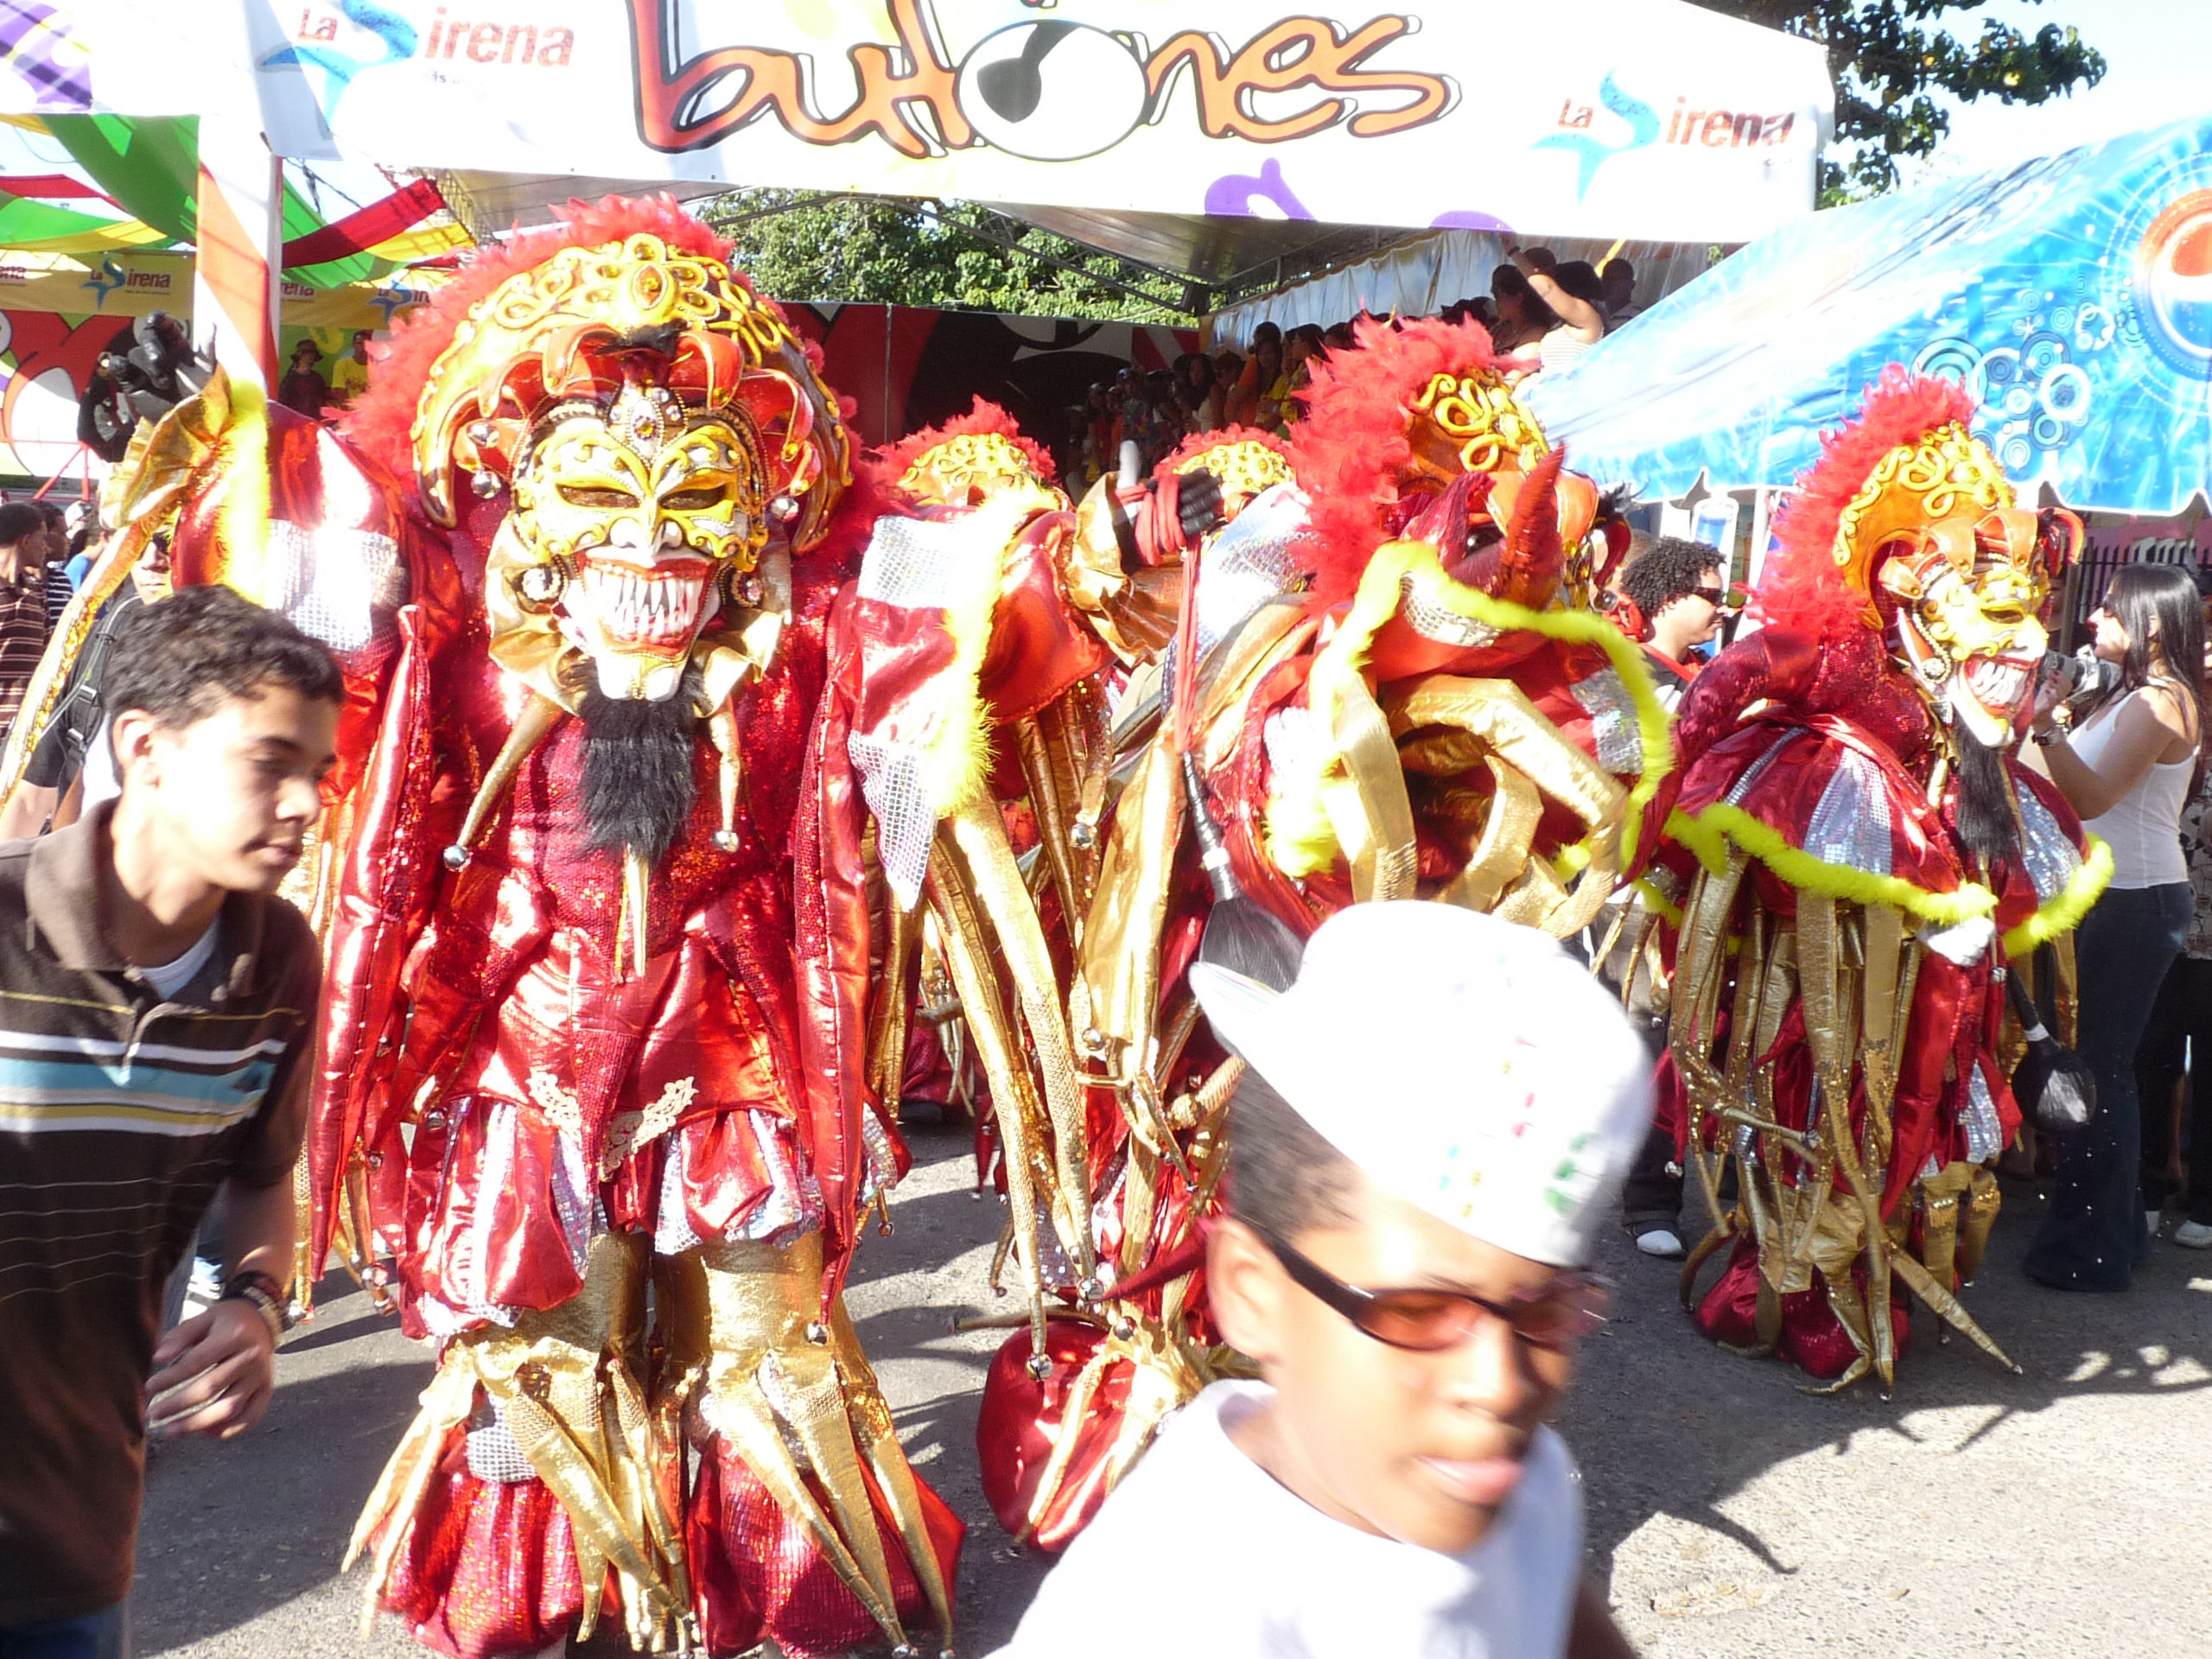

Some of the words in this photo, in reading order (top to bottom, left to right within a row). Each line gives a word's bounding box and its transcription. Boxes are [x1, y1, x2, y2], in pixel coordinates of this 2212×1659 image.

[297, 7, 339, 41] La
[1558, 99, 1593, 129] La
[1598, 66, 1795, 149] Sirena
[90, 269, 104, 281] La
[103, 257, 171, 289] Sirena
